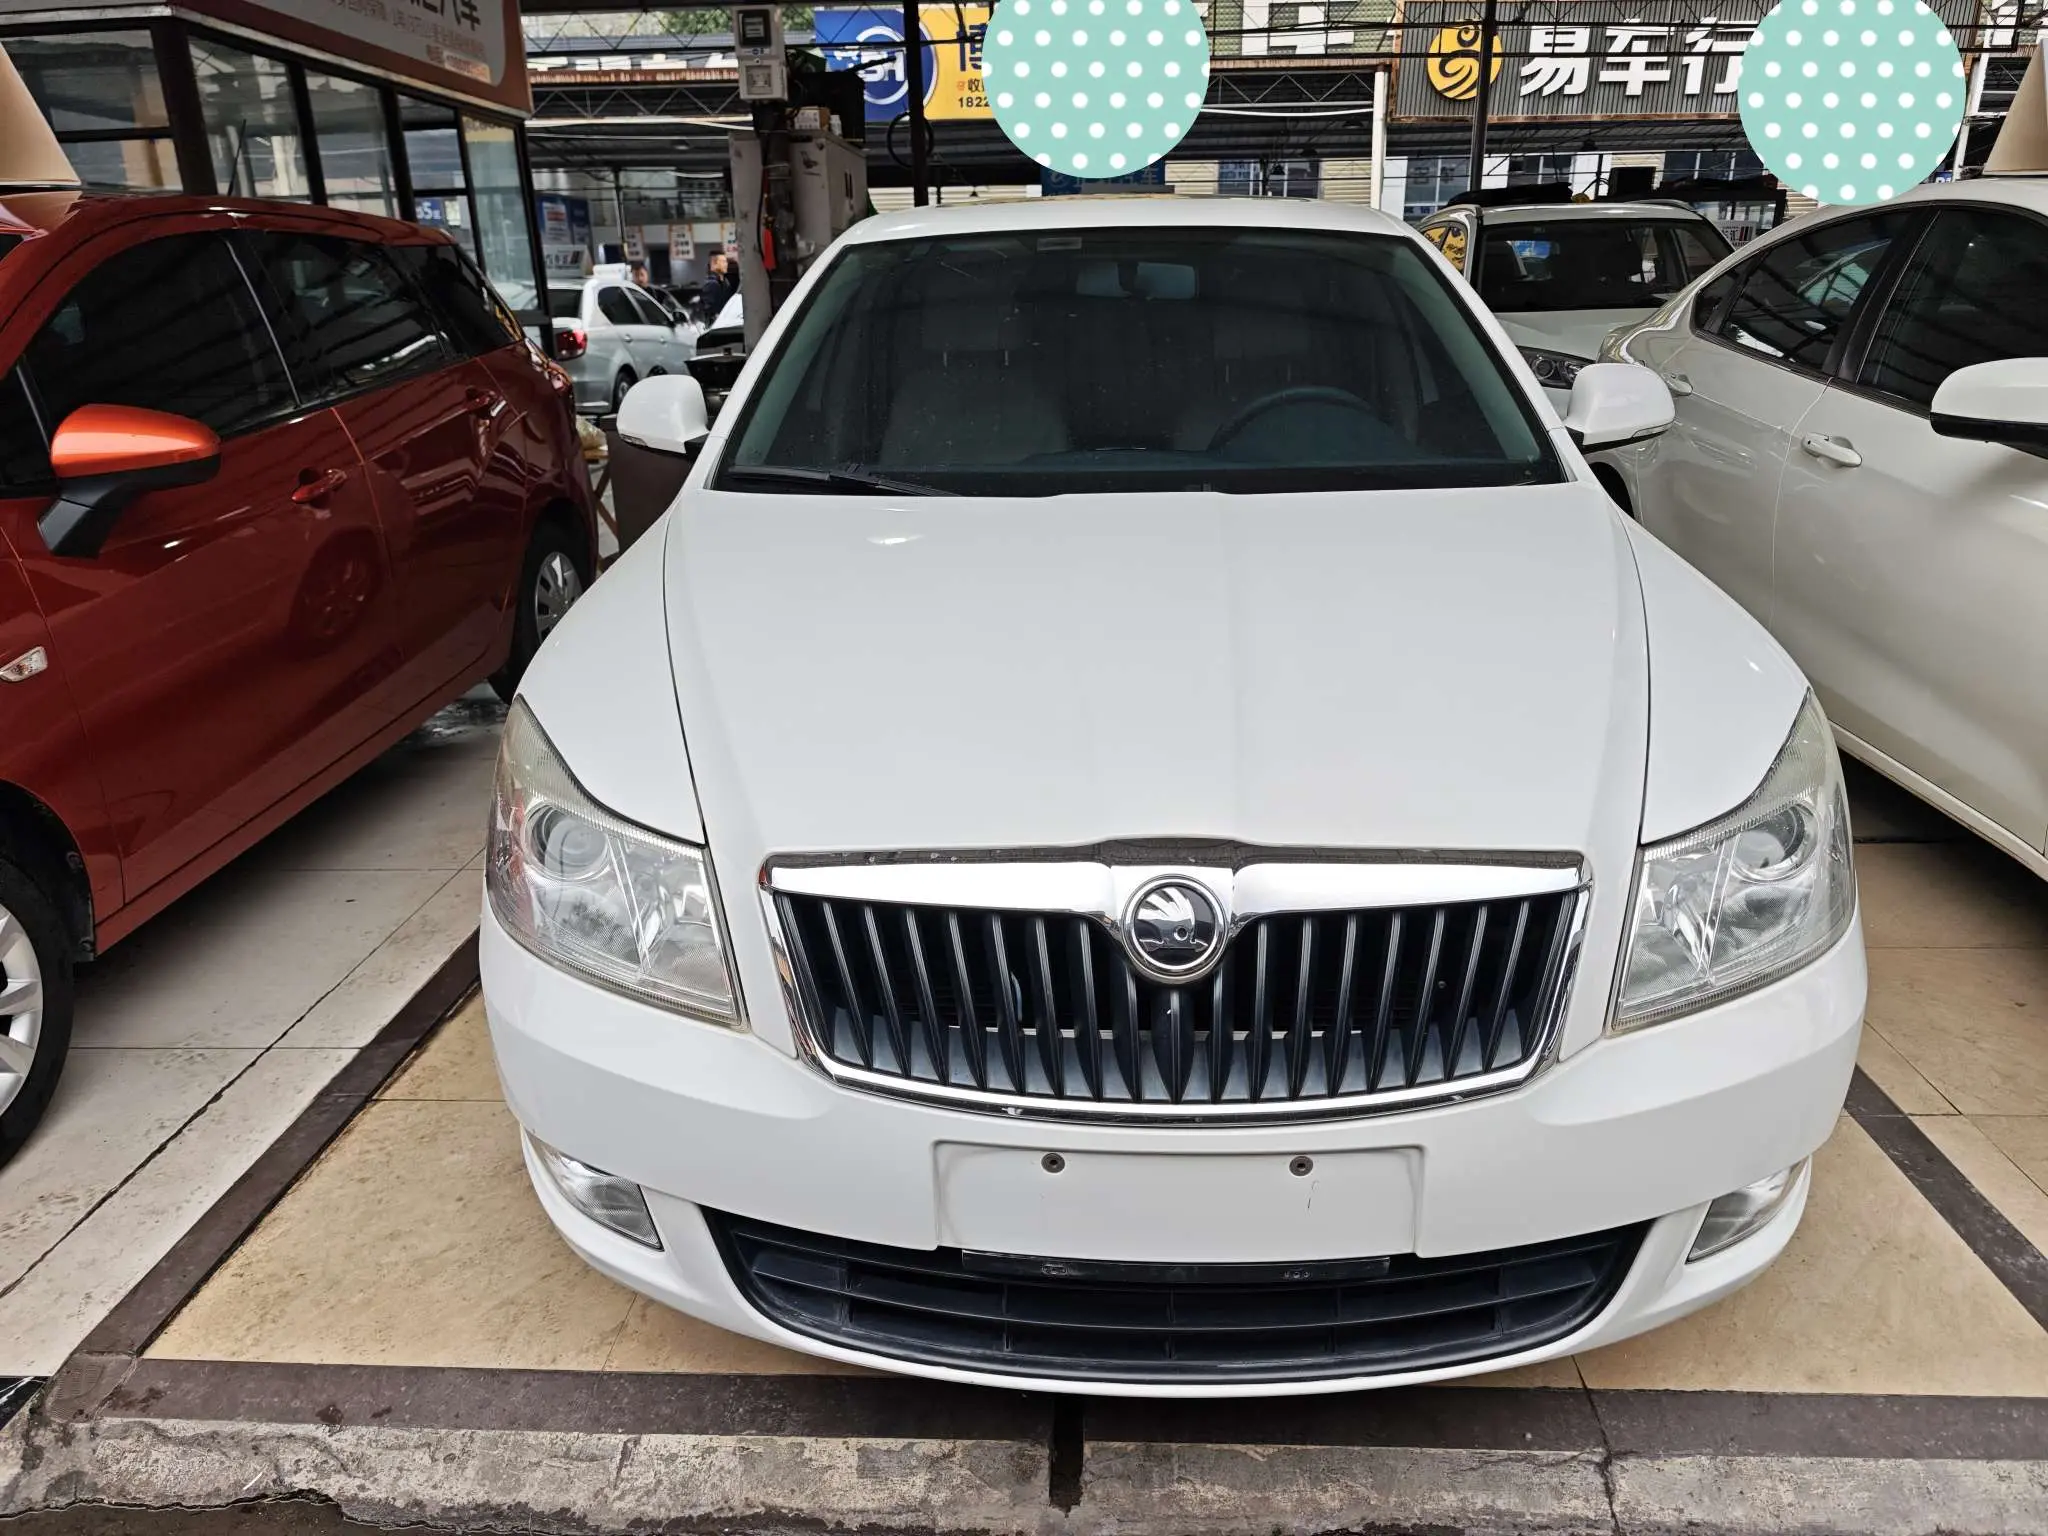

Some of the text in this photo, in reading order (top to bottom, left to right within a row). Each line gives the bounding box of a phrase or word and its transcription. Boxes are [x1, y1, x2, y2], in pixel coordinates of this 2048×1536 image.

[1520, 18, 1758, 96] 易车行
[968, 78, 985, 93] 收
